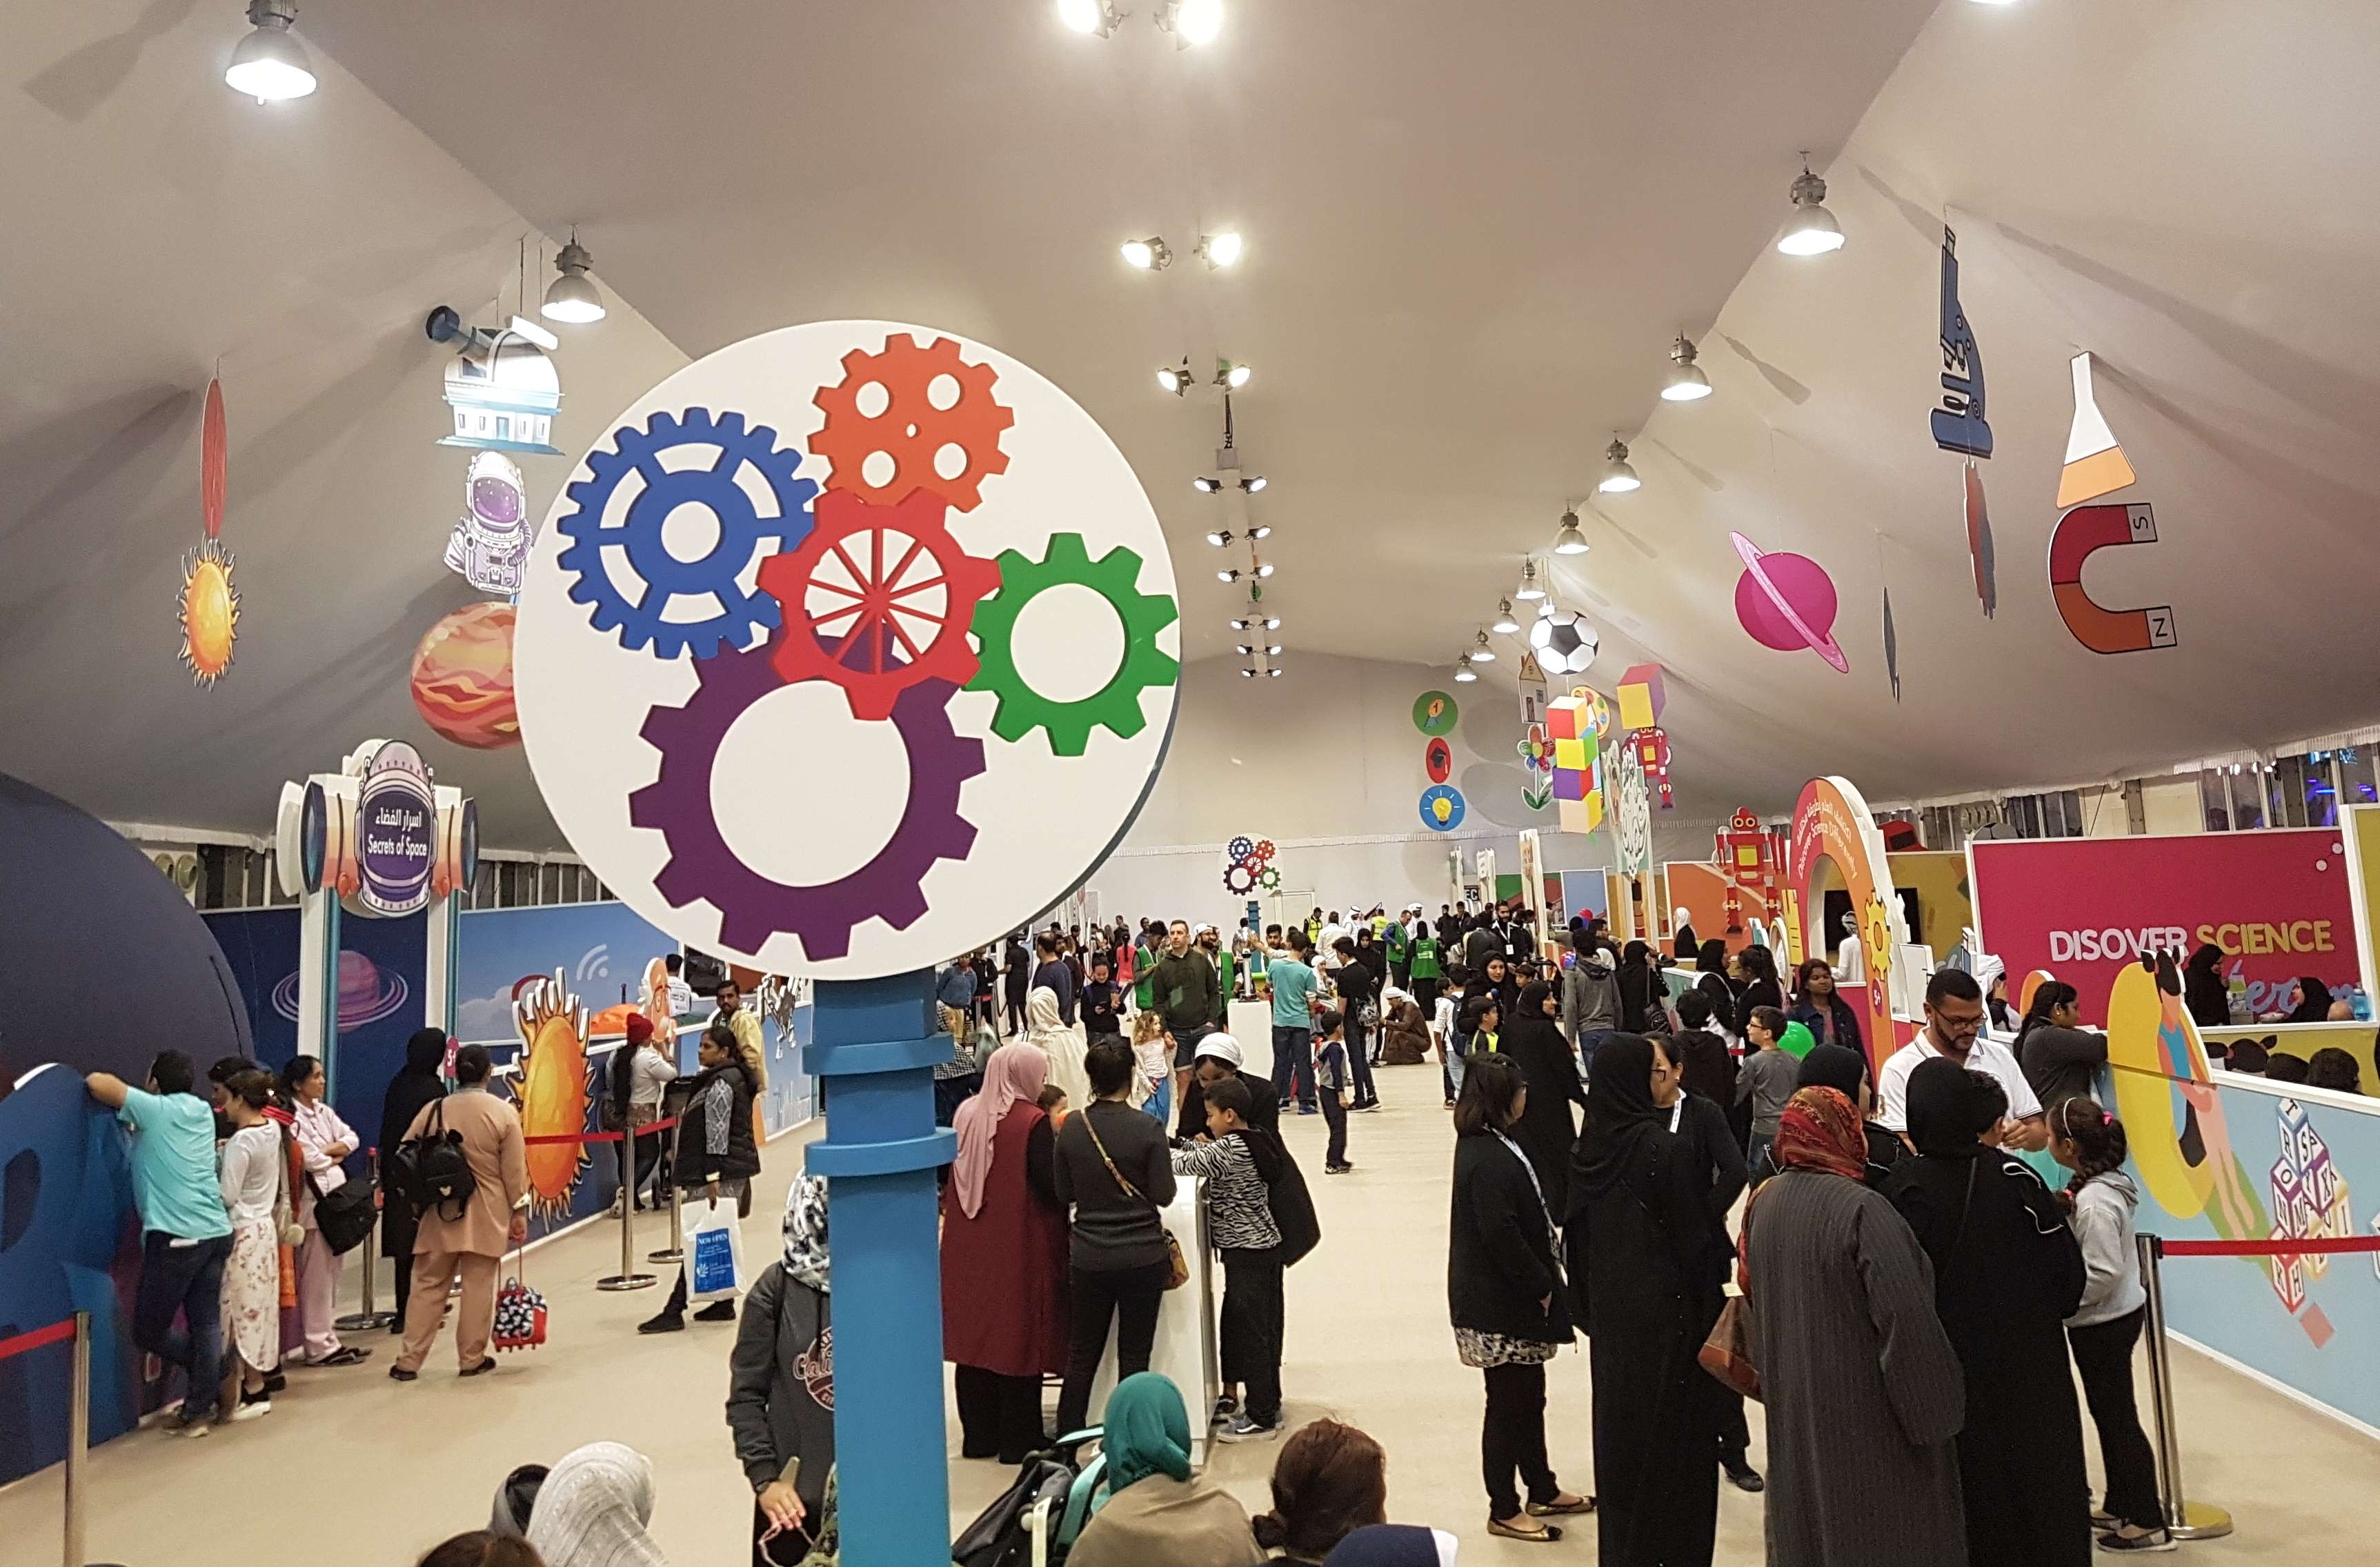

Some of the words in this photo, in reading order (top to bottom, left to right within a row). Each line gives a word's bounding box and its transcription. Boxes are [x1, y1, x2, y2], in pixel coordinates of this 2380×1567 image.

[375, 806, 401, 826] الفضاء
[368, 833, 395, 855] Secrets
[396, 834, 405, 855] of
[405, 836, 427, 861] Space
[1798, 831, 1812, 881] Discover
[1810, 819, 1829, 839] Science
[1828, 821, 1858, 879] Differently
[2196, 919, 2335, 956] SCIENCE
